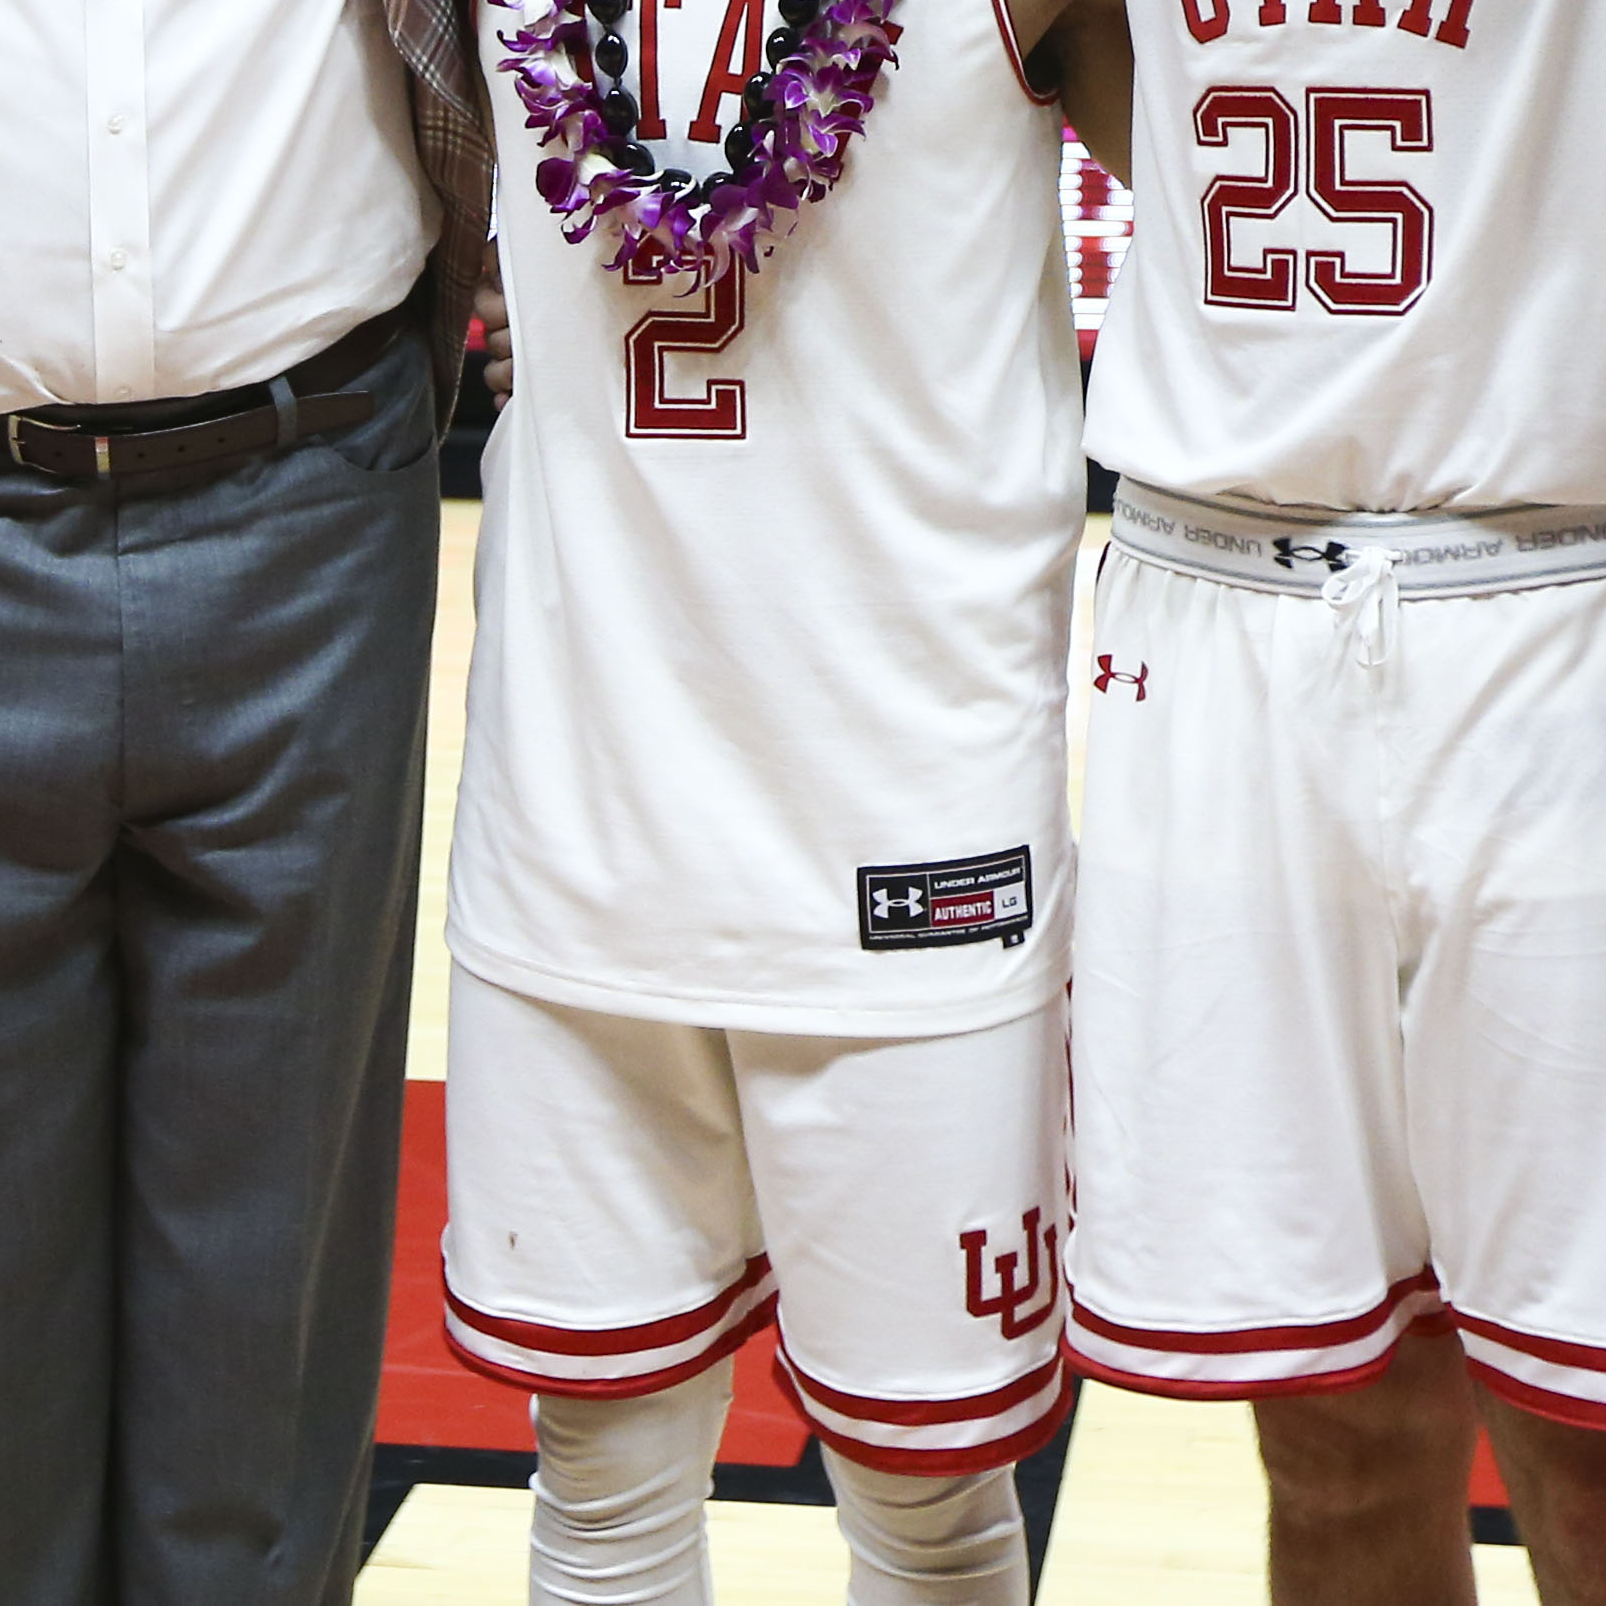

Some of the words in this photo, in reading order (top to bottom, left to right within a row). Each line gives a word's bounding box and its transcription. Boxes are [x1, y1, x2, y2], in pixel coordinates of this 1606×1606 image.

[1193, 84, 1435, 316] 25
[624, 232, 747, 440] 2
[1184, 525, 1263, 558] UNDER
[934, 876, 976, 890] UNDER
[977, 867, 1021, 885] ARMOUR
[934, 900, 993, 922] AUTHENTIC
[1001, 896, 1018, 908] LG
